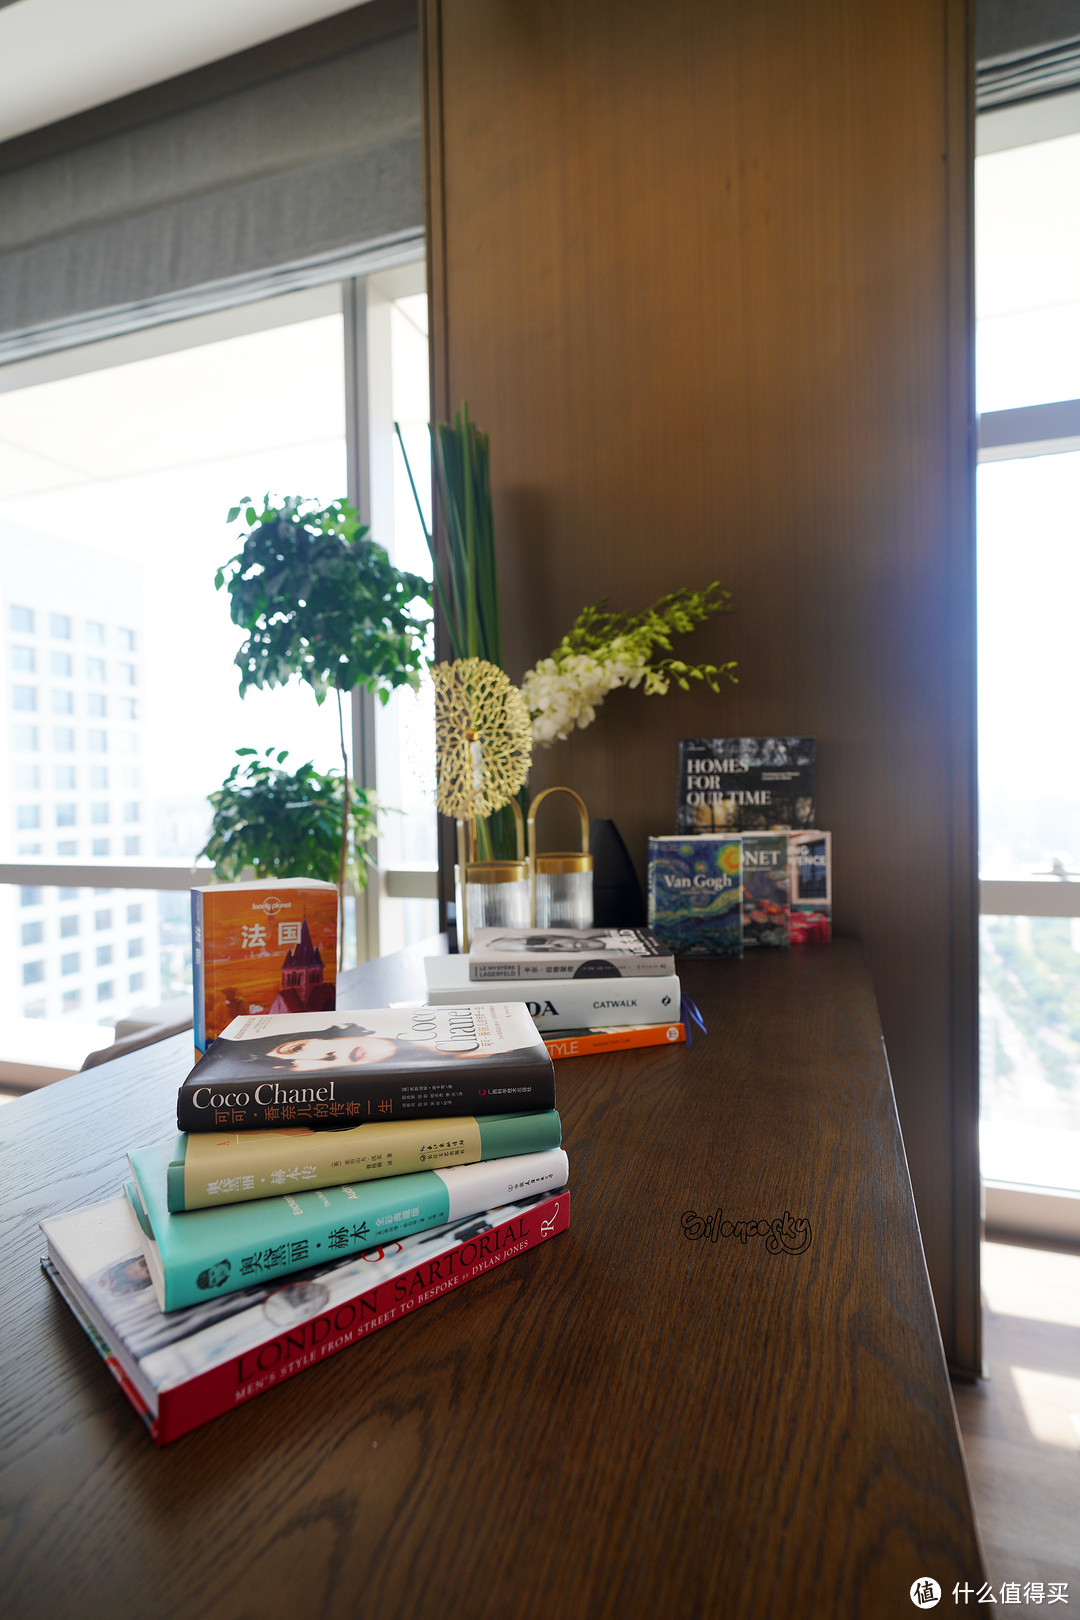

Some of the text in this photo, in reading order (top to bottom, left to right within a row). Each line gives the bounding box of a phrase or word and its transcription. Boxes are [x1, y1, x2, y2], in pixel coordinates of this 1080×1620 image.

[687, 758, 750, 774] HOMES
[687, 775, 721, 790] FOR
[686, 790, 772, 806] OUR TIME
[664, 873, 732, 891] Van Gogh
[241, 921, 302, 949] 法国
[593, 999, 638, 1010] CATWALK
[396, 1008, 438, 1042] Coco
[435, 1007, 480, 1053] Chanel
[547, 1041, 580, 1057] TYLE
[192, 1081, 335, 1109] Coco Chanel
[215, 1098, 393, 1124] 可可·香奈儿的传奇一生
[240, 1221, 371, 1276] 奥黛丽·赫本
[238, 1218, 531, 1385] LONDON SARTORIAL
[235, 1373, 276, 1401] MEN'S
[280, 1350, 316, 1378] STYLE
[321, 1331, 353, 1355] FROM
[357, 1308, 397, 1336] STREET
[400, 1300, 414, 1312] TO
[418, 1276, 459, 1304] BESPOKE
[472, 1254, 501, 1276] DYLAN
[503, 1239, 529, 1260] JONES
